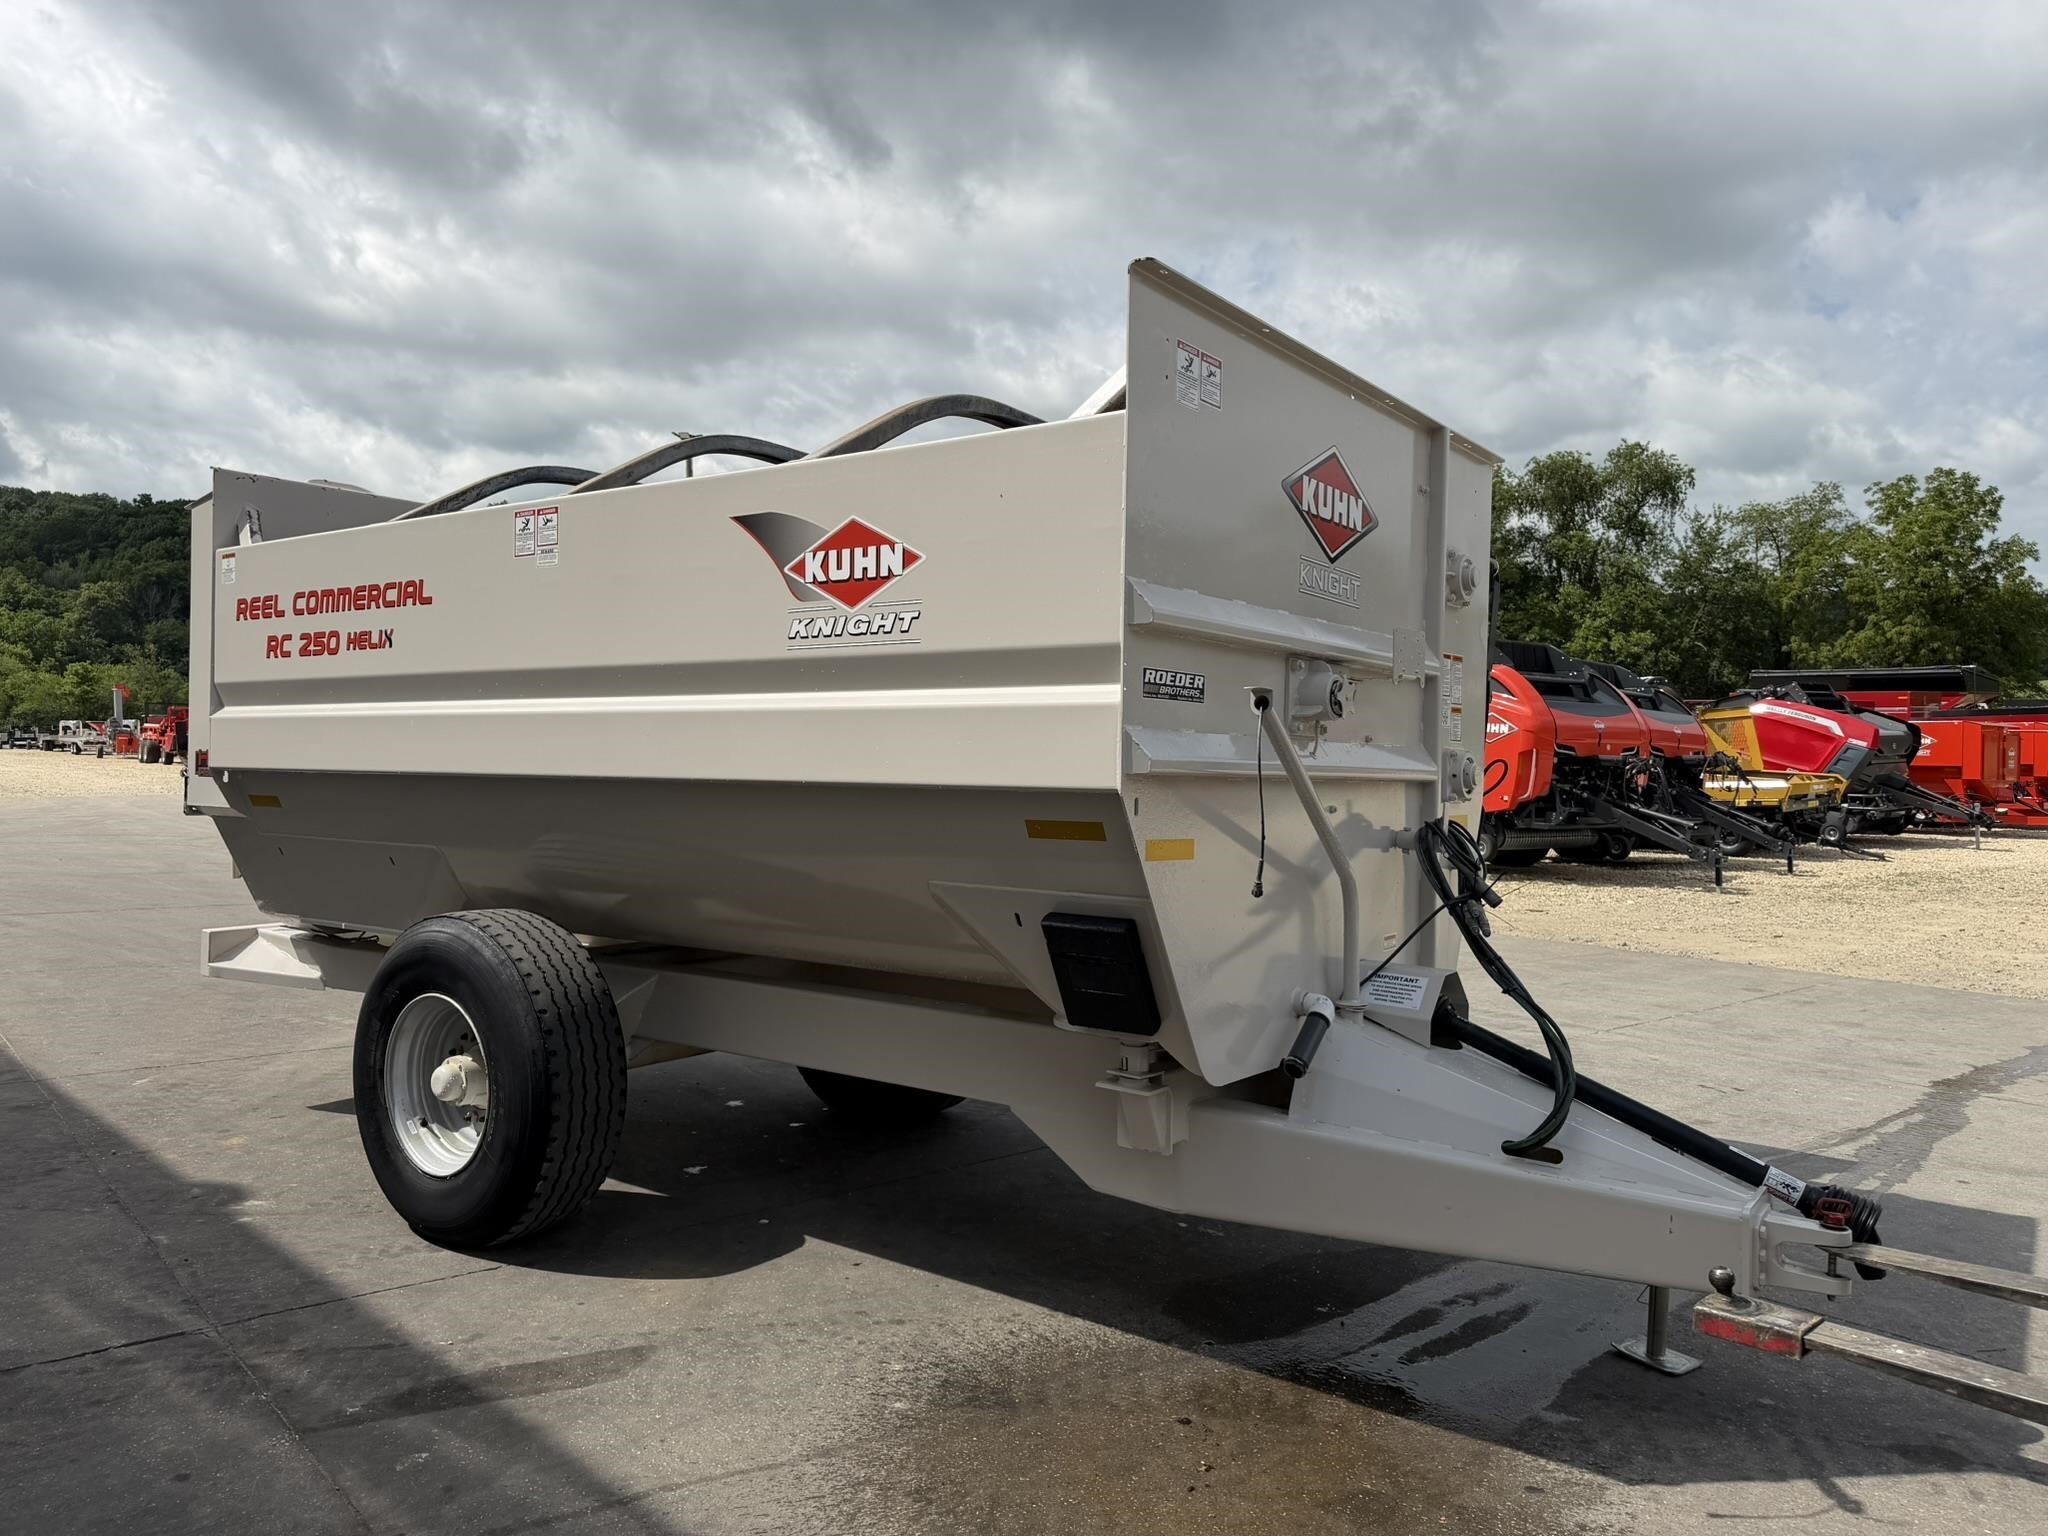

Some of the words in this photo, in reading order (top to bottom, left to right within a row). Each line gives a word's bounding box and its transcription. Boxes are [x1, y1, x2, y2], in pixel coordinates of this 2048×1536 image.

[1301, 474, 1363, 533] KUHN
[804, 542, 904, 584] KUHN
[1299, 562, 1361, 601] KNIGHT
[236, 594, 285, 621] REEL
[292, 579, 433, 616] COMMERCIAL
[787, 610, 921, 640] KNIGHT
[266, 634, 293, 659] RC
[299, 630, 341, 657] 250
[346, 628, 394, 651] HELIX
[1144, 669, 1204, 689] ROEDER
[1159, 685, 1201, 698] BROTHERS
[1487, 723, 1509, 734] HN
[1375, 973, 1420, 984] IMPORTANT
